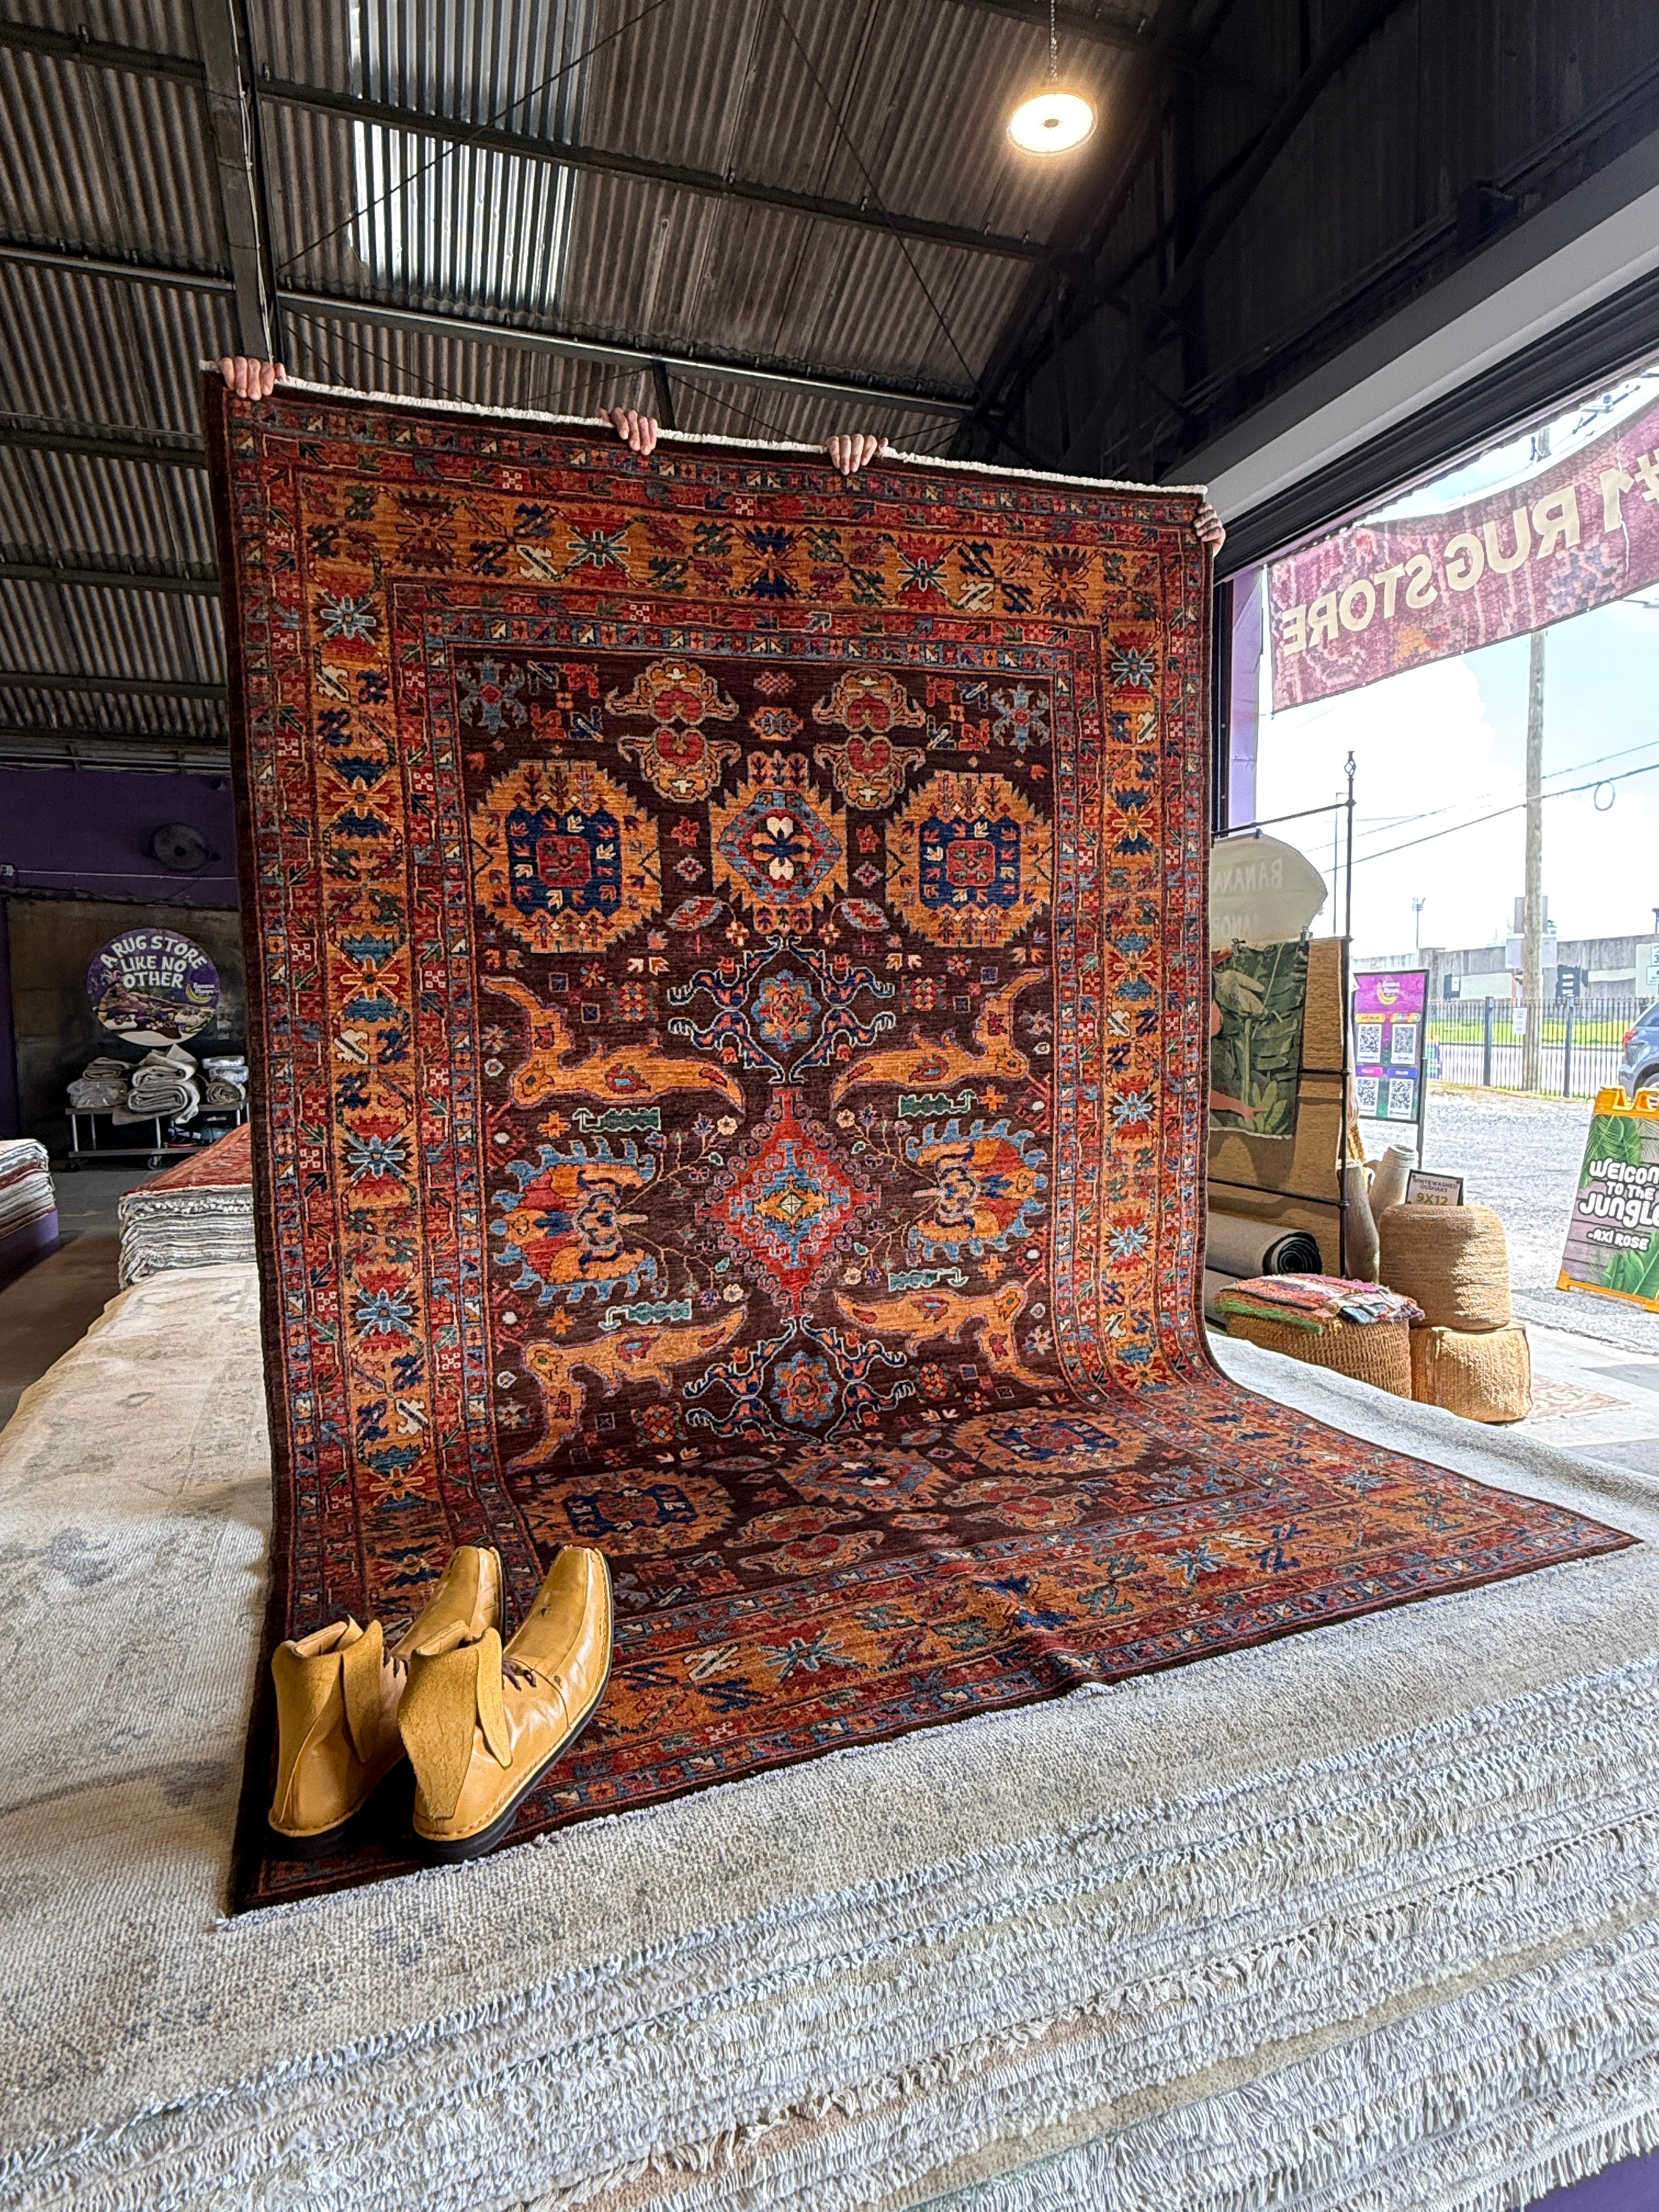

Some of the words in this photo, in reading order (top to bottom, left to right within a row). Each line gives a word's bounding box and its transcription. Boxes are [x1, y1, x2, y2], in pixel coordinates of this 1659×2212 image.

[100, 953, 119, 969] A
[111, 935, 147, 958] RUG
[150, 936, 207, 969] STORE
[120, 956, 157, 973] LIKE
[161, 957, 187, 972] NO
[123, 971, 184, 989] OTHER
[1606, 1181, 1624, 1195] TO
[1627, 1184, 1656, 1200] THE
[1615, 1233, 1649, 1251] ROSE
